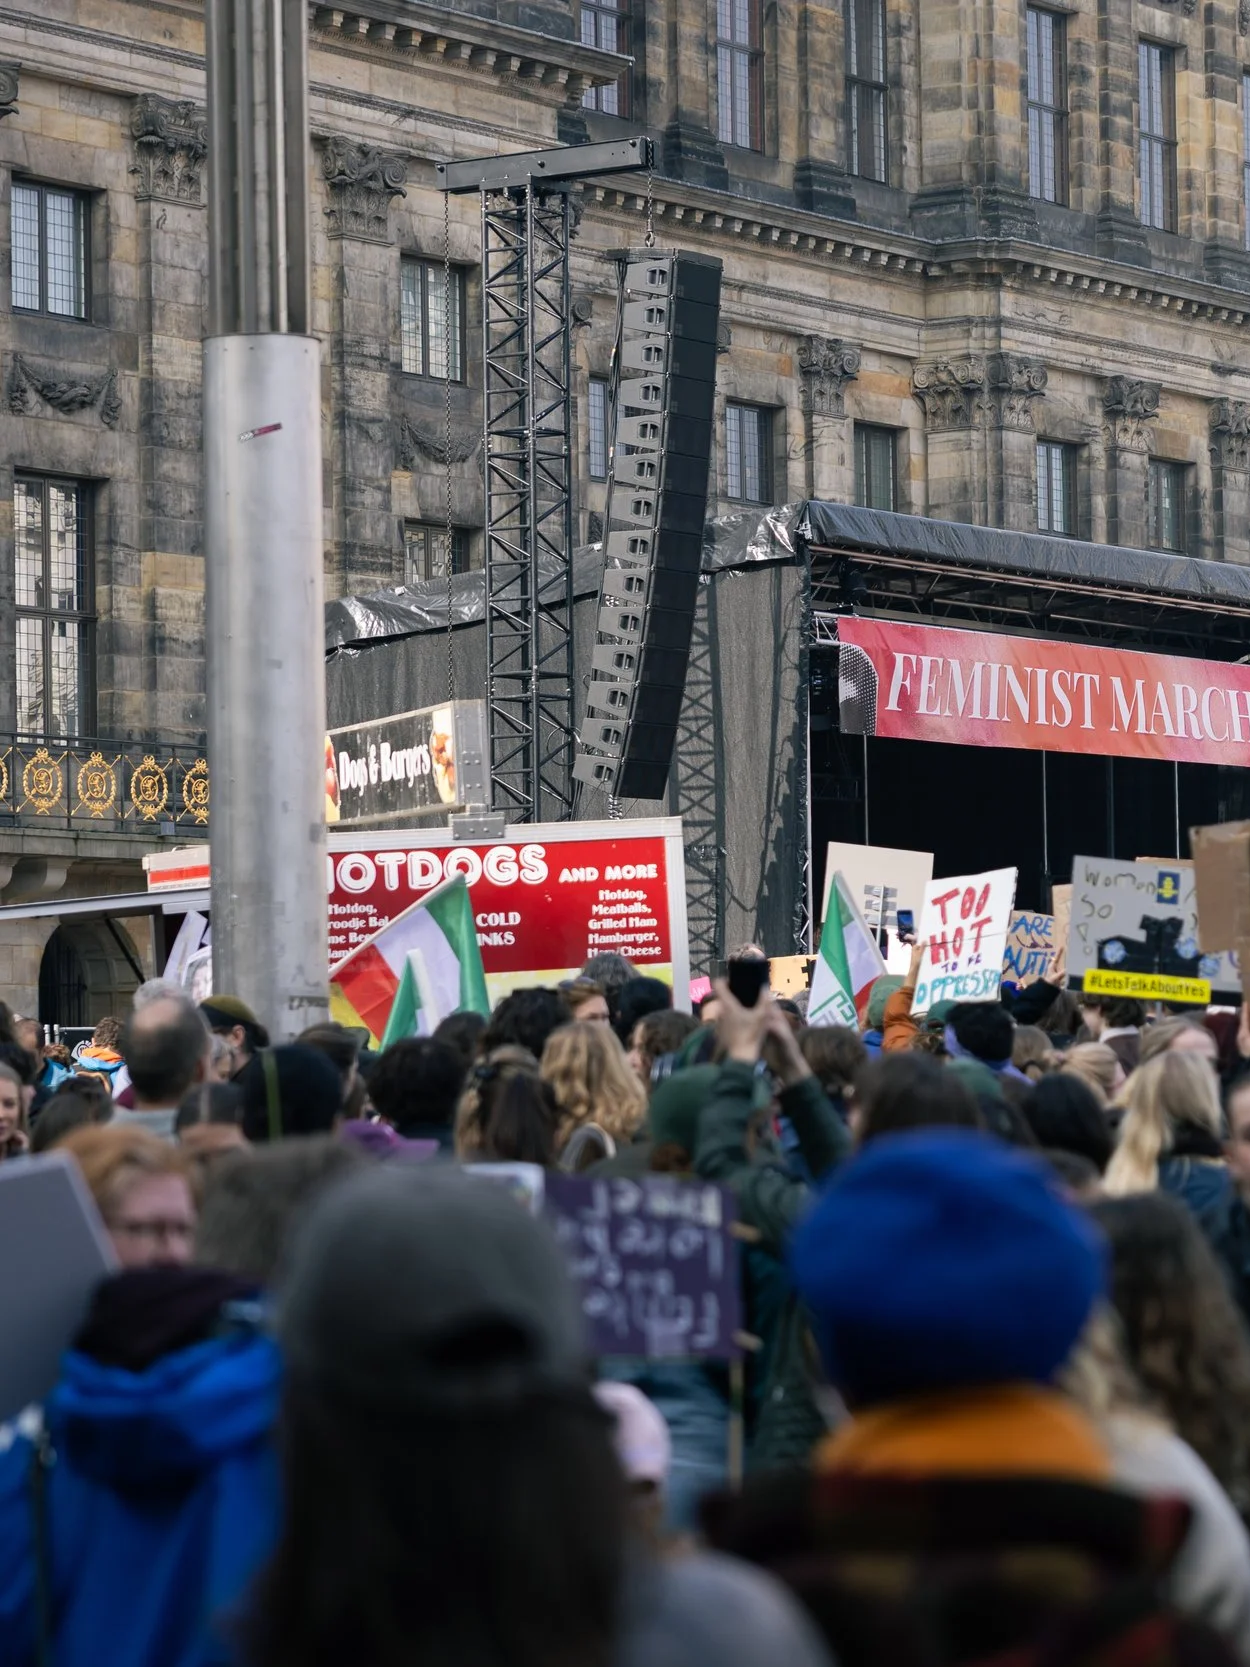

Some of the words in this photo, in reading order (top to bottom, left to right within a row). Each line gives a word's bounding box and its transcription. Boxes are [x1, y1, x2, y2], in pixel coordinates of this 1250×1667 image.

[885, 652, 1100, 729] FEMINIST
[339, 752, 368, 797] Dogs
[368, 744, 379, 785] &
[380, 742, 431, 788] Burgers
[558, 866, 600, 884] AND
[604, 864, 659, 880] MORE
[931, 883, 991, 926] TOO
[327, 917, 367, 930] roodje
[475, 911, 522, 928] COLD
[588, 918, 627, 930] Grilled
[628, 917, 658, 928] Ham
[1010, 915, 1055, 937] ARE
[475, 931, 516, 948] INKS
[929, 916, 993, 965] HOT
